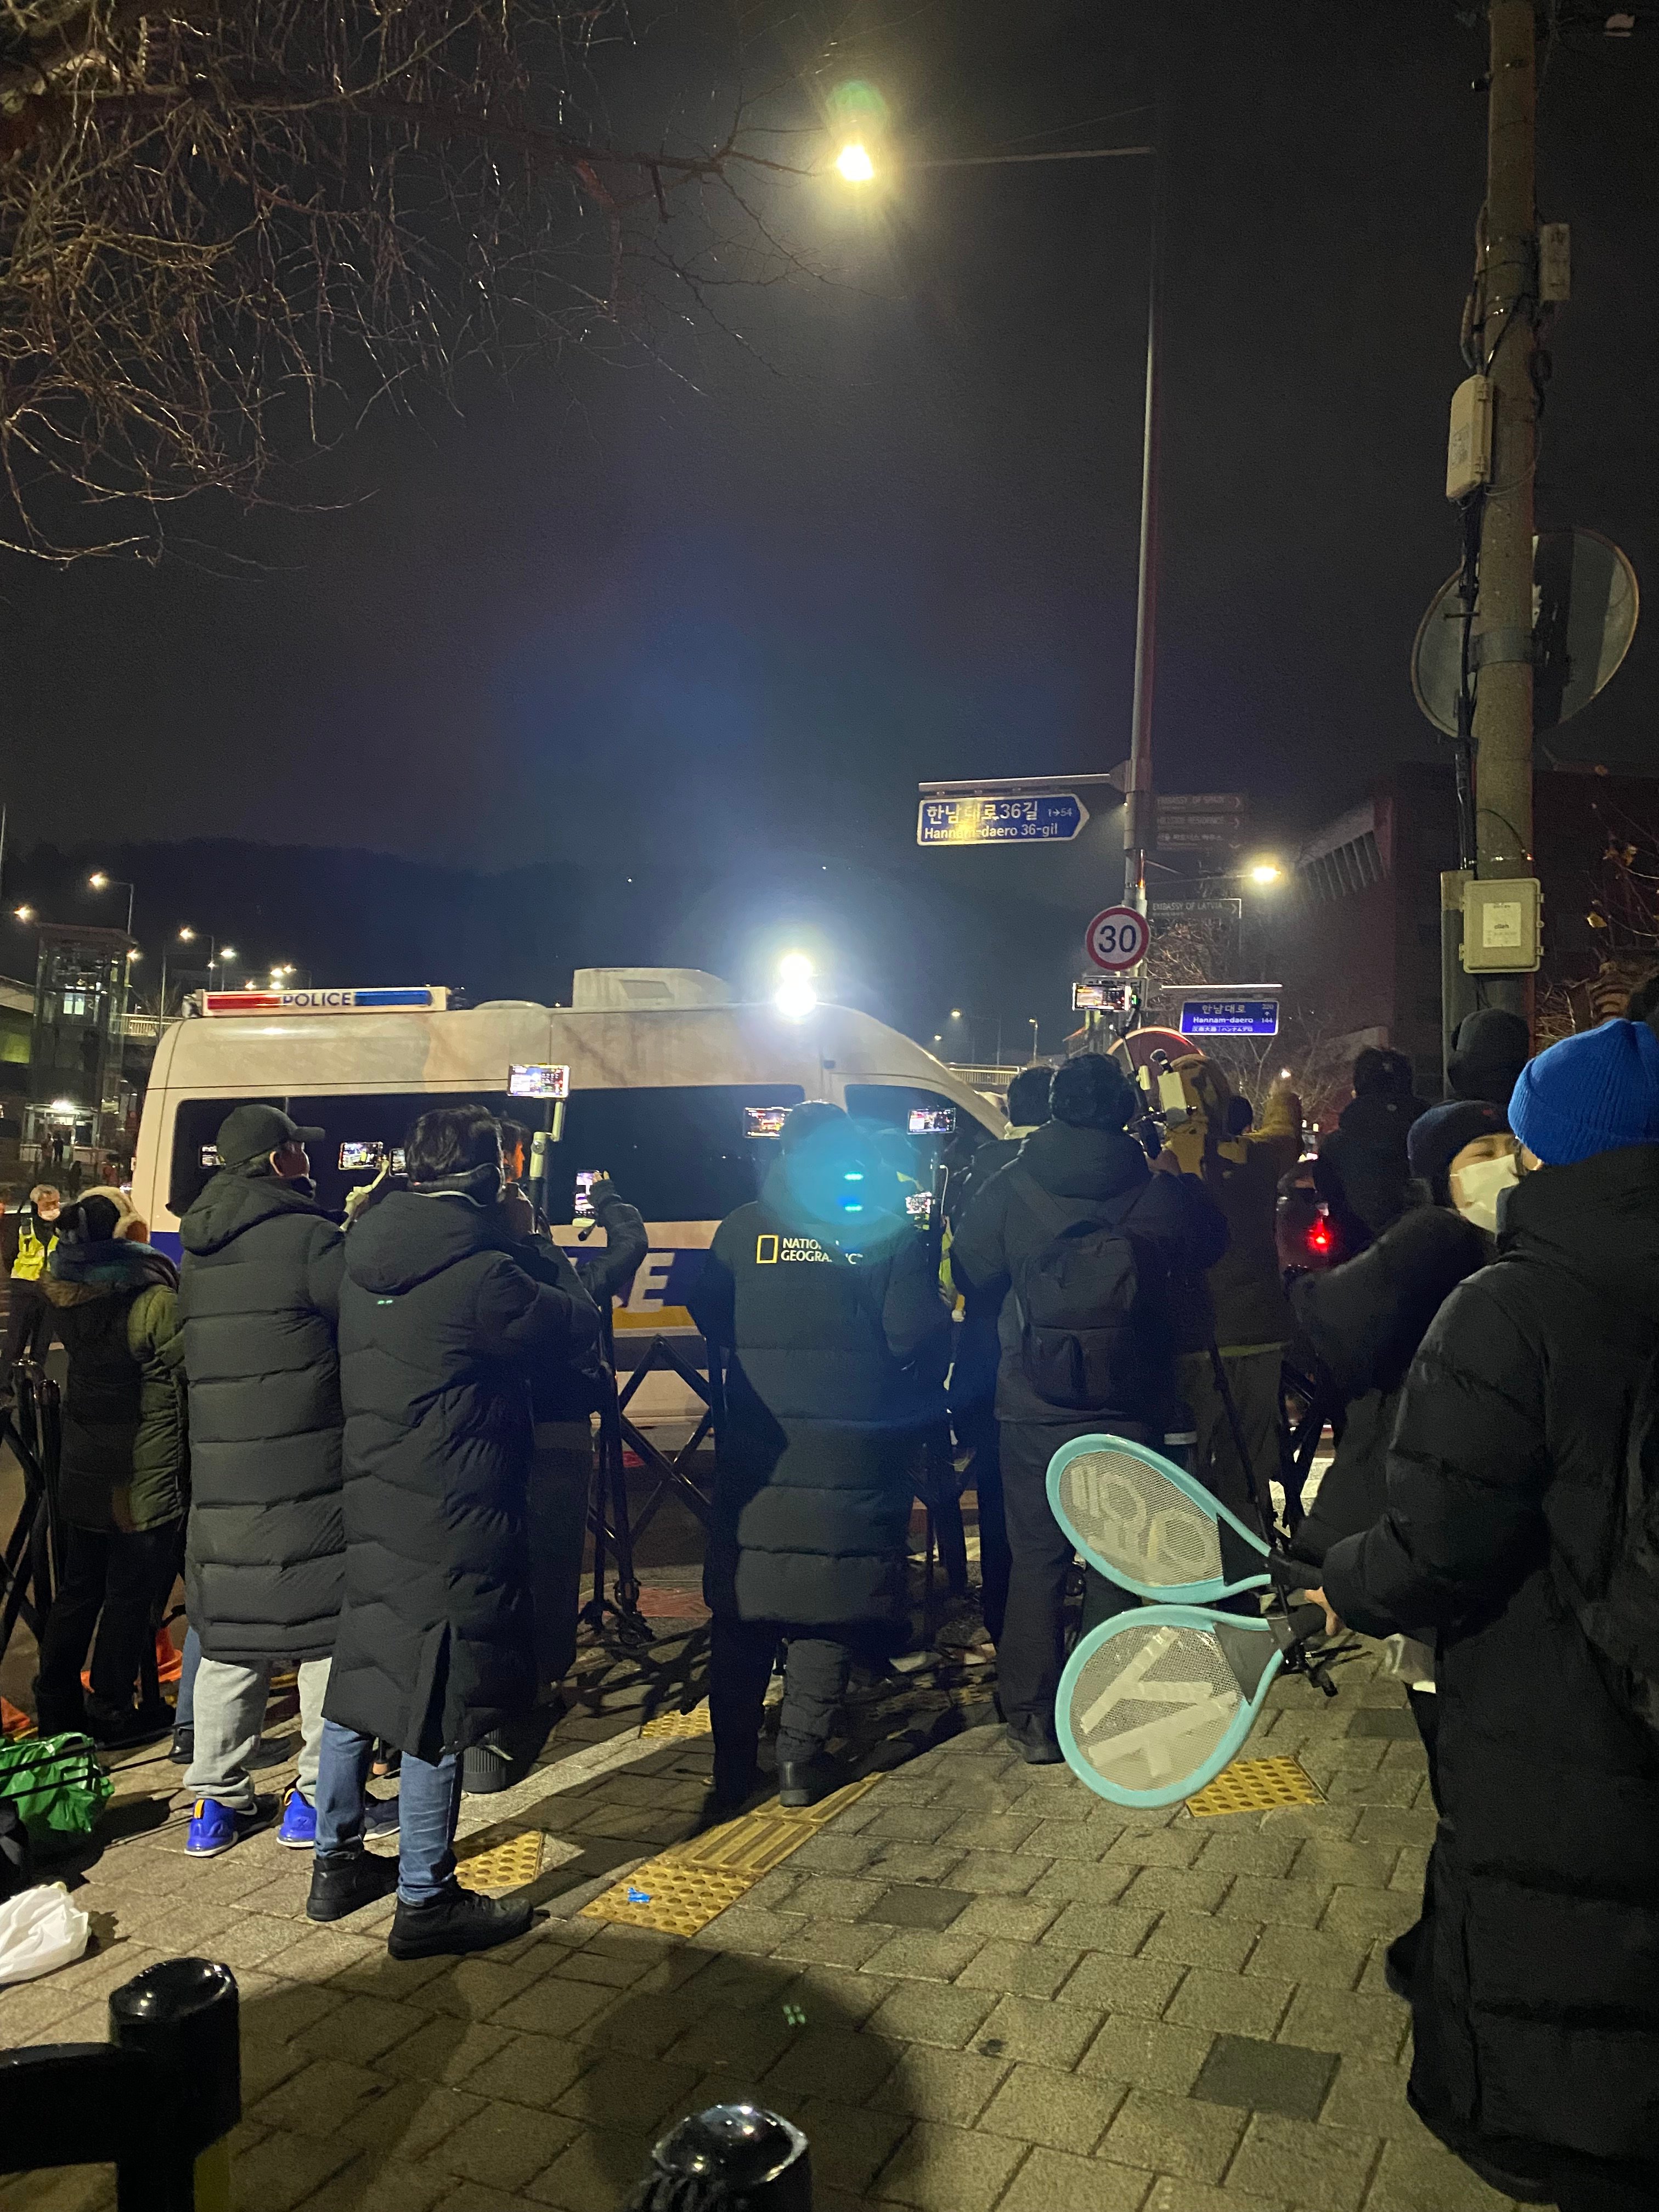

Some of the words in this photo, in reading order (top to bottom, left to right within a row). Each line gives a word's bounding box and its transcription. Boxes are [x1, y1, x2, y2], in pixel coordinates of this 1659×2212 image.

[926, 800, 1039, 825] 한남대로36길
[924, 825, 1018, 839] Hannam-daero
[1021, 822, 1058, 838] 36-gil
[1152, 902, 1183, 911] EMBASSY
[1098, 924, 1137, 953] 30
[283, 992, 351, 1007] POLICE
[1202, 1004, 1246, 1014] 한남대로
[782, 1238, 839, 1250] NATIO
[780, 1250, 857, 1265] GEOGRAC
